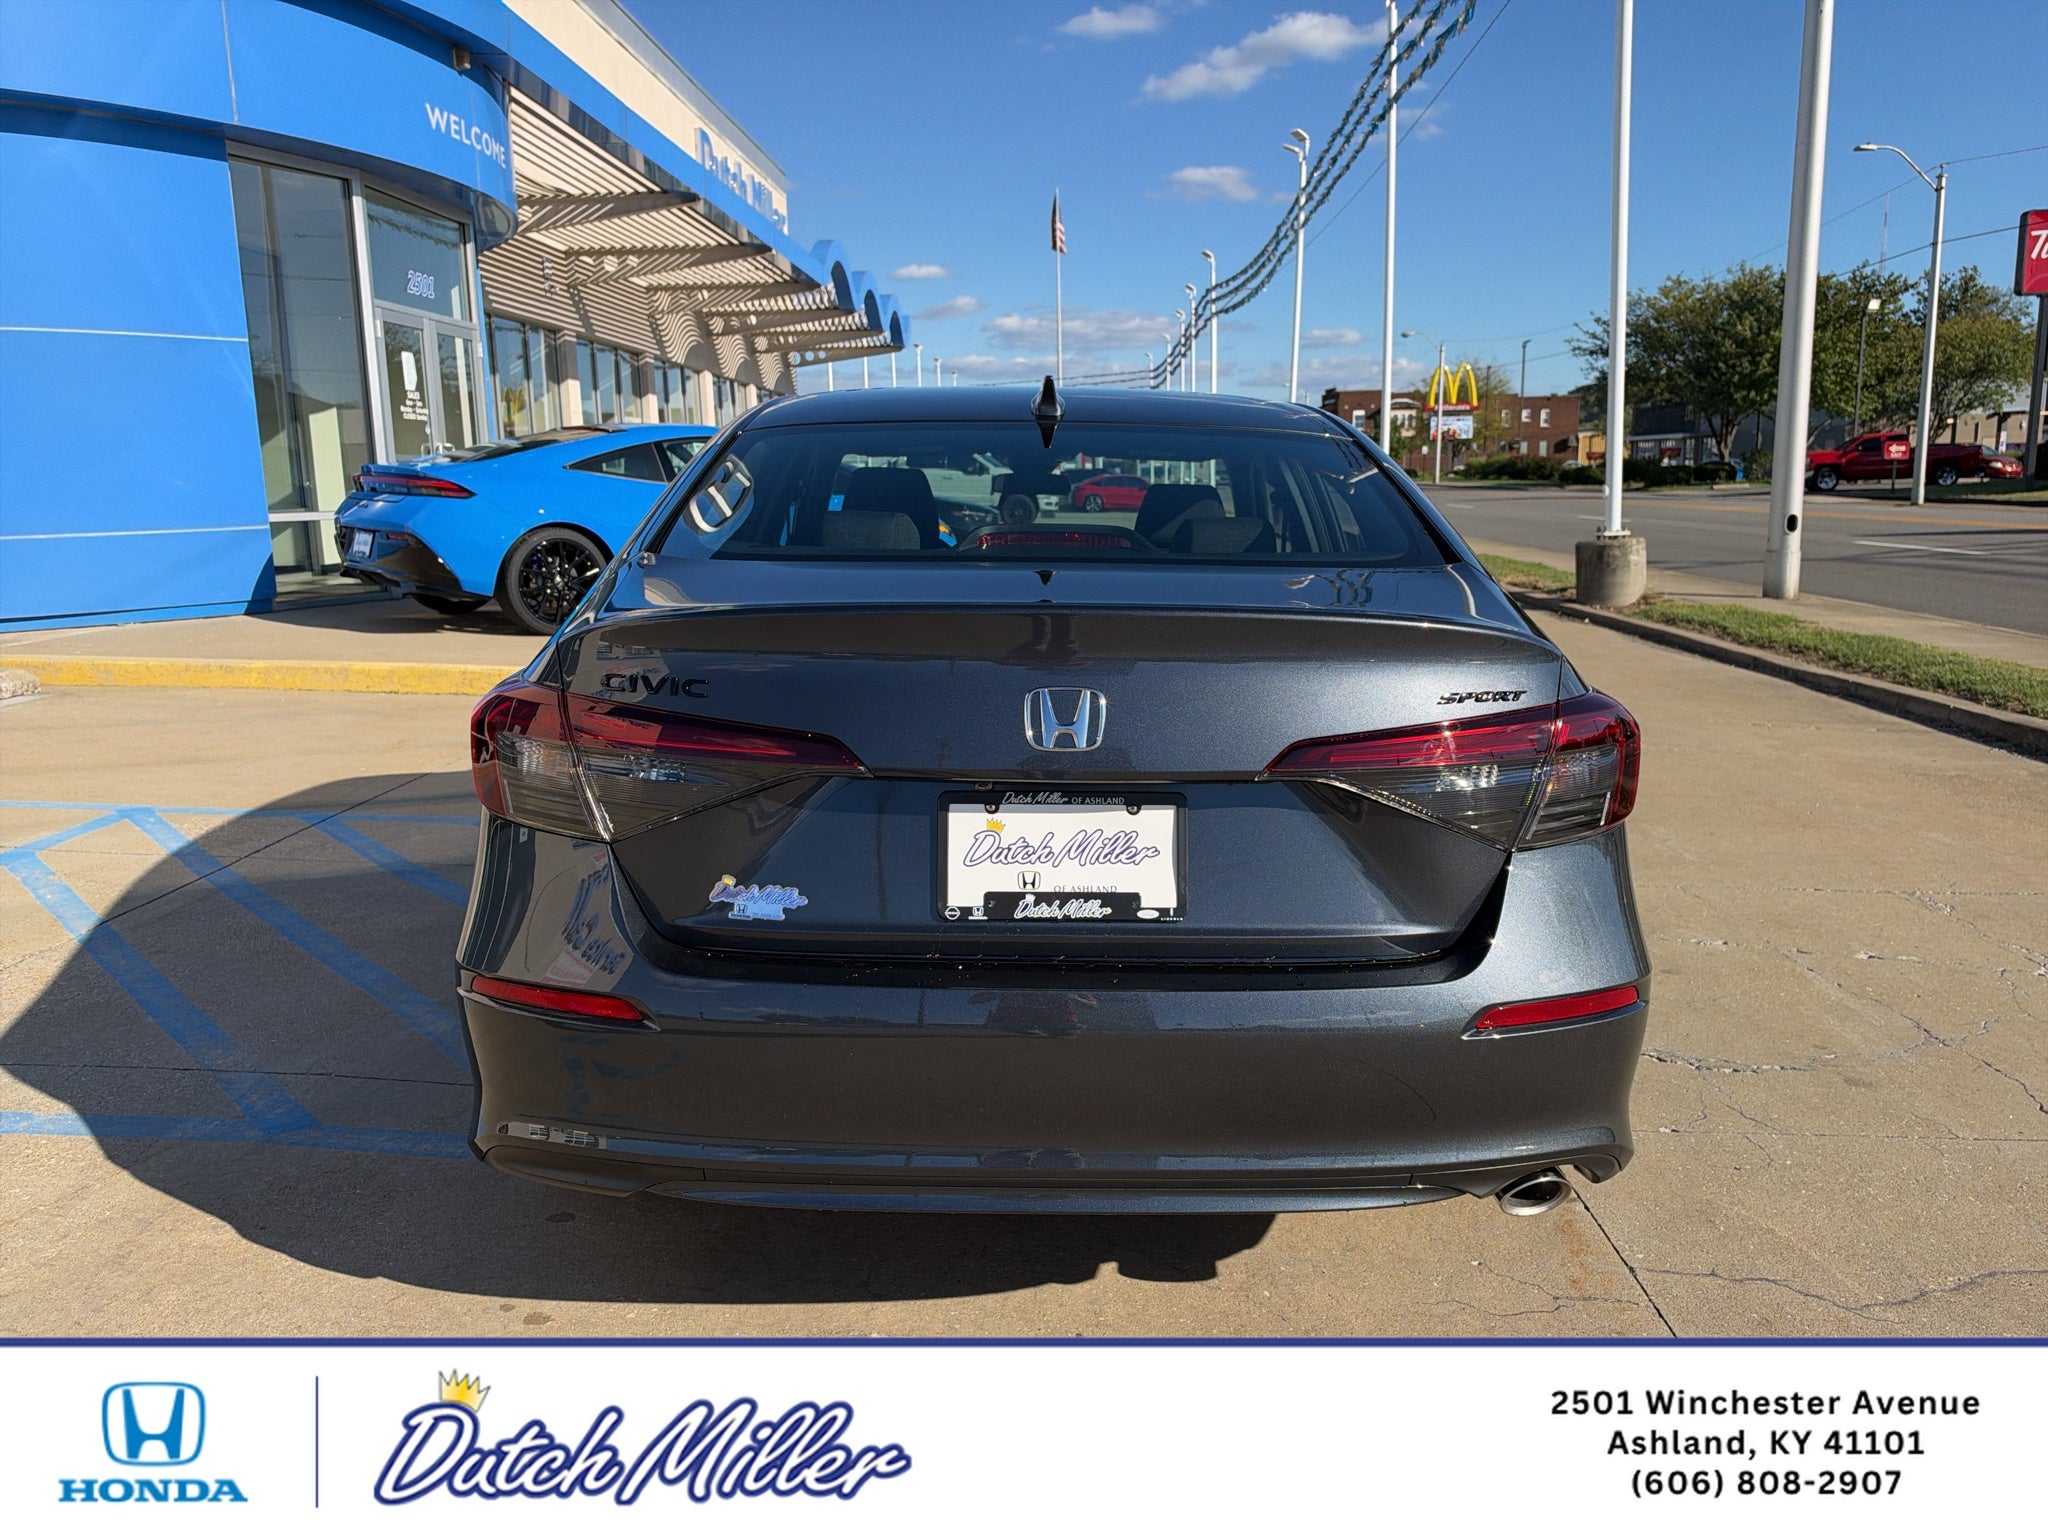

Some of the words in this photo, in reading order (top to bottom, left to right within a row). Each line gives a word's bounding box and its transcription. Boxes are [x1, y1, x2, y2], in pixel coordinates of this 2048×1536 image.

[425, 103, 506, 169] WELCOME
[407, 270, 435, 299] 2501
[601, 673, 709, 698] CIVIC
[1437, 690, 1528, 705] SPORT
[1001, 791, 1033, 805] Dutch
[1032, 791, 1069, 806] Miller
[1084, 797, 1125, 805] ASHLAND
[963, 829, 1054, 867] Dutch
[1052, 828, 1161, 868] Miller
[1014, 898, 1060, 919] Dutch
[1057, 898, 1112, 919] Miller
